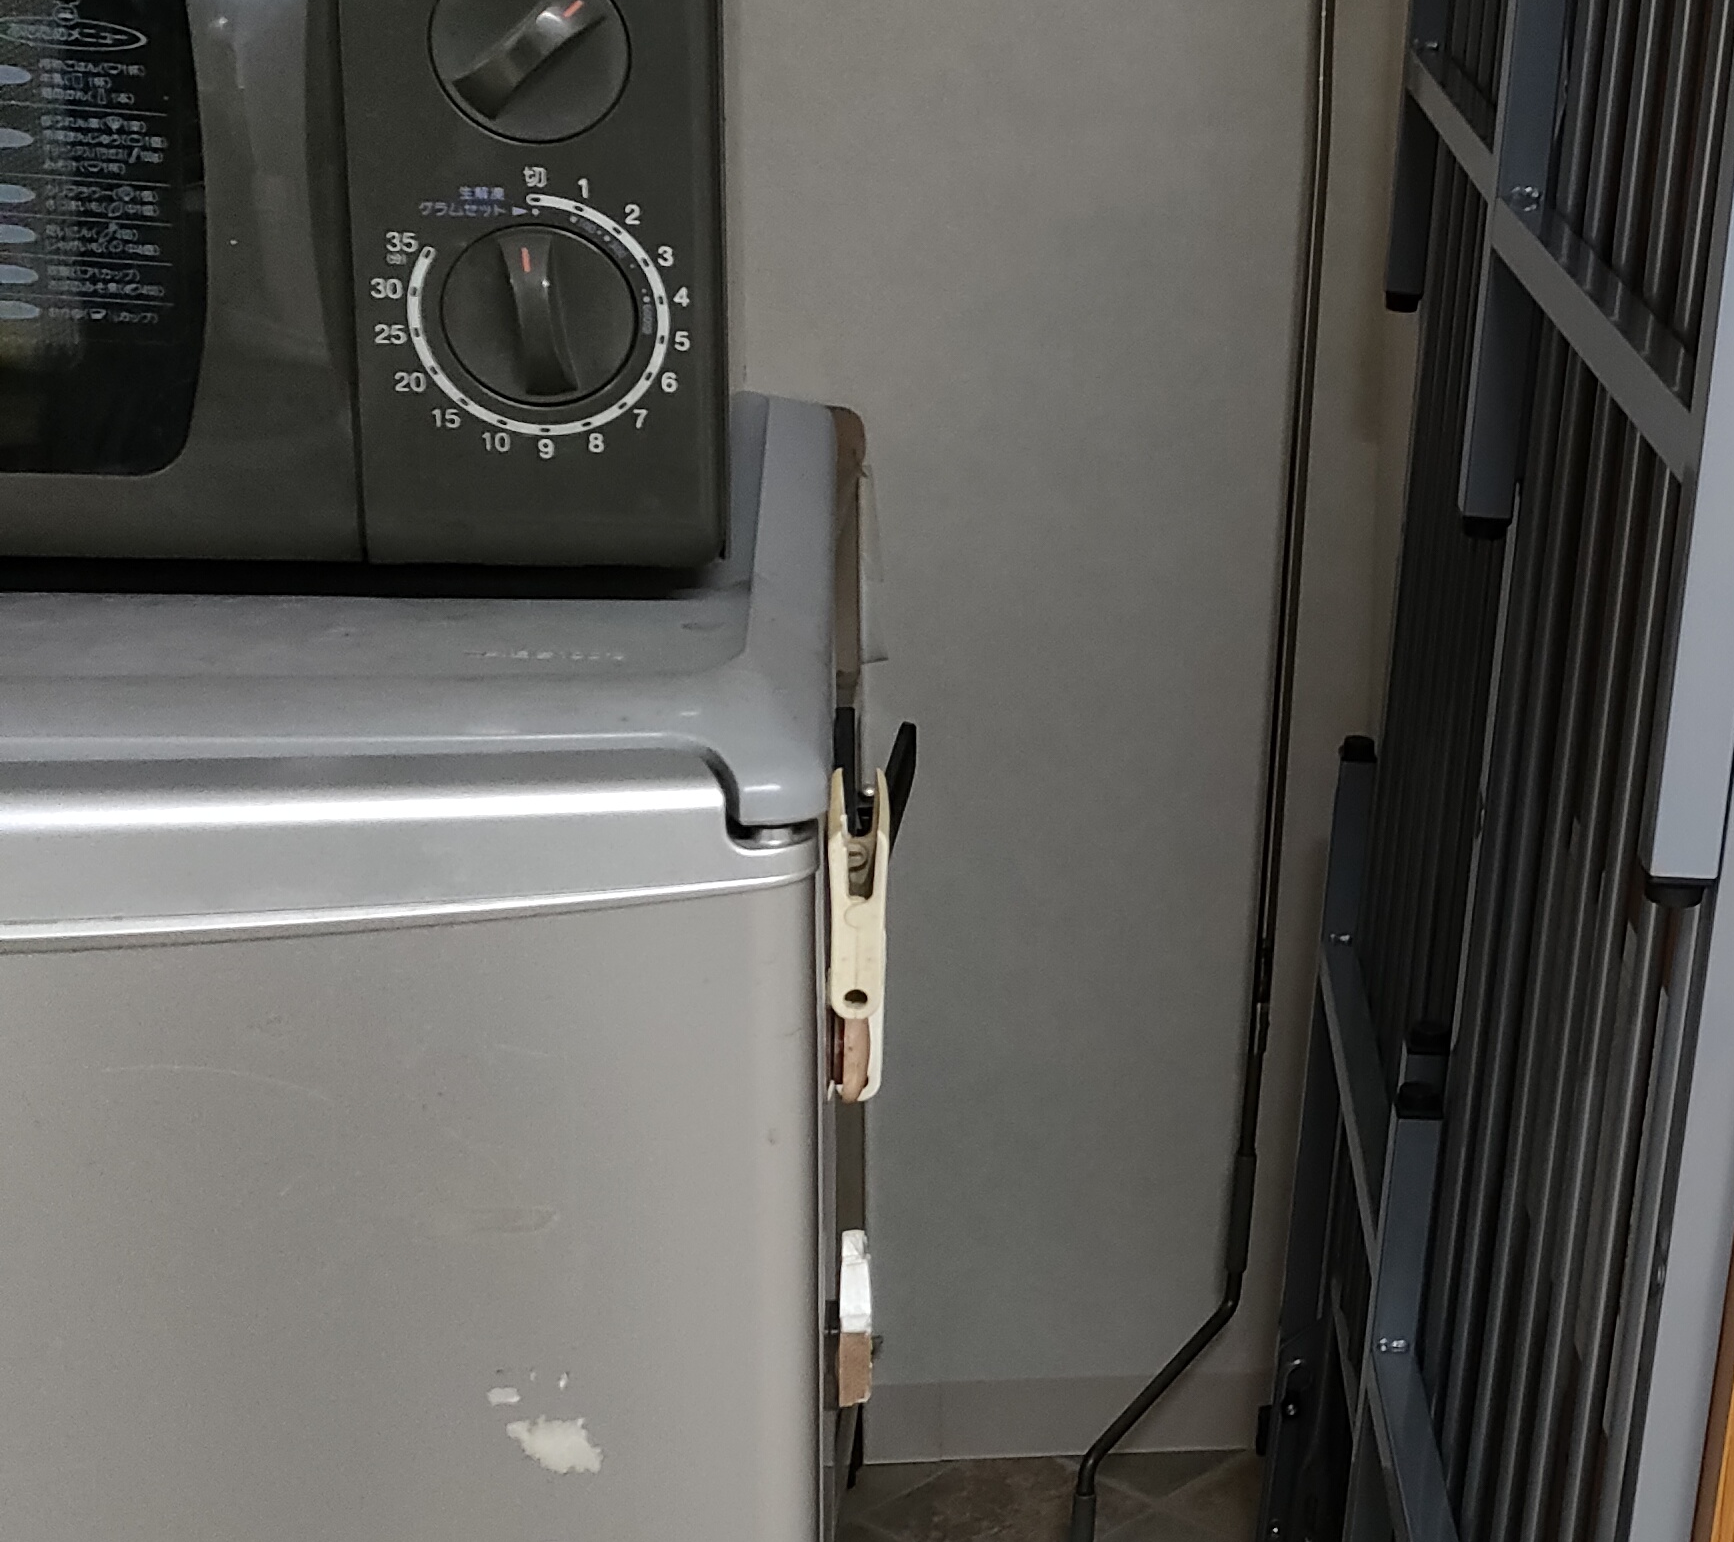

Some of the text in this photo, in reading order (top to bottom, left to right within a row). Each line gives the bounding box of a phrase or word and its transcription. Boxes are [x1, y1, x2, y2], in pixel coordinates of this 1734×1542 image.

[523, 166, 547, 187] 切
[577, 178, 589, 198] 1
[624, 204, 641, 225] 2
[386, 231, 419, 252] 35
[657, 245, 674, 266] 3
[370, 278, 403, 299] 30
[673, 286, 690, 307] 4
[374, 323, 408, 344] 25
[674, 331, 691, 351] 5
[394, 372, 427, 393] 20
[660, 372, 678, 393] 6
[431, 408, 461, 429] 15
[632, 409, 648, 429] 7
[482, 432, 511, 452] 10
[537, 439, 554, 459] 9
[588, 432, 605, 453] 8
